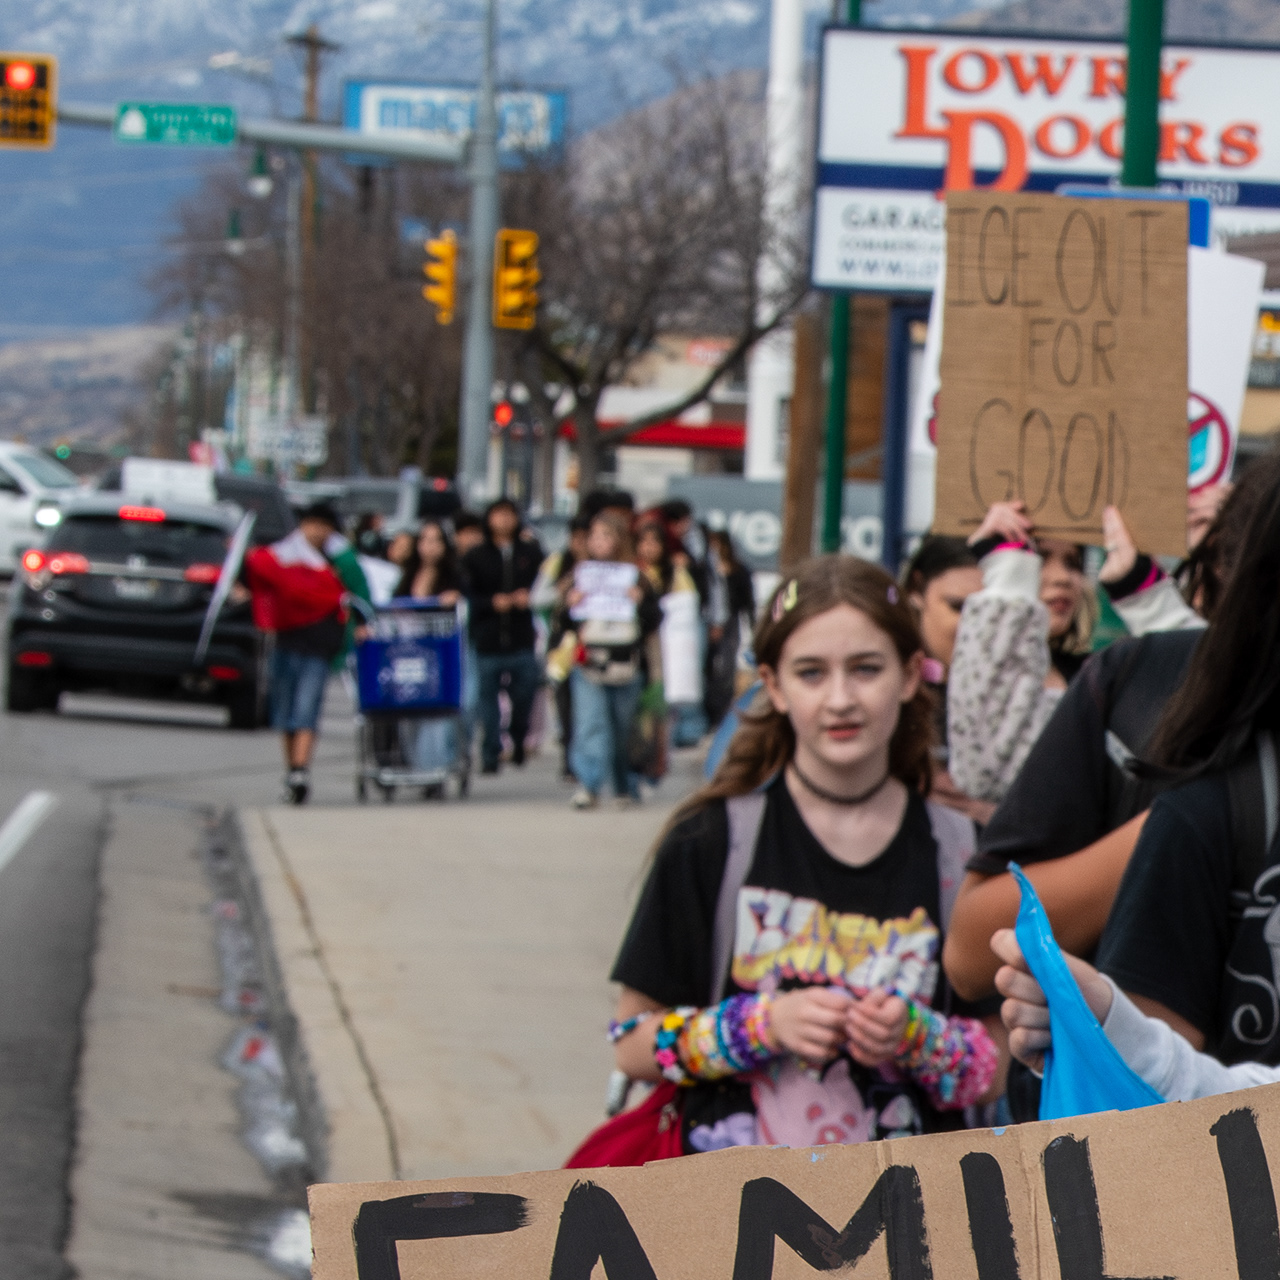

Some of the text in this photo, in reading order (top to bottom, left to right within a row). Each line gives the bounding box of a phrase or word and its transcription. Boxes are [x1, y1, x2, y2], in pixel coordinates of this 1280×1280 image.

[946, 205, 1165, 319] ICE OUT
[1025, 317, 1118, 388] FOR
[968, 397, 1131, 521] GOOD
